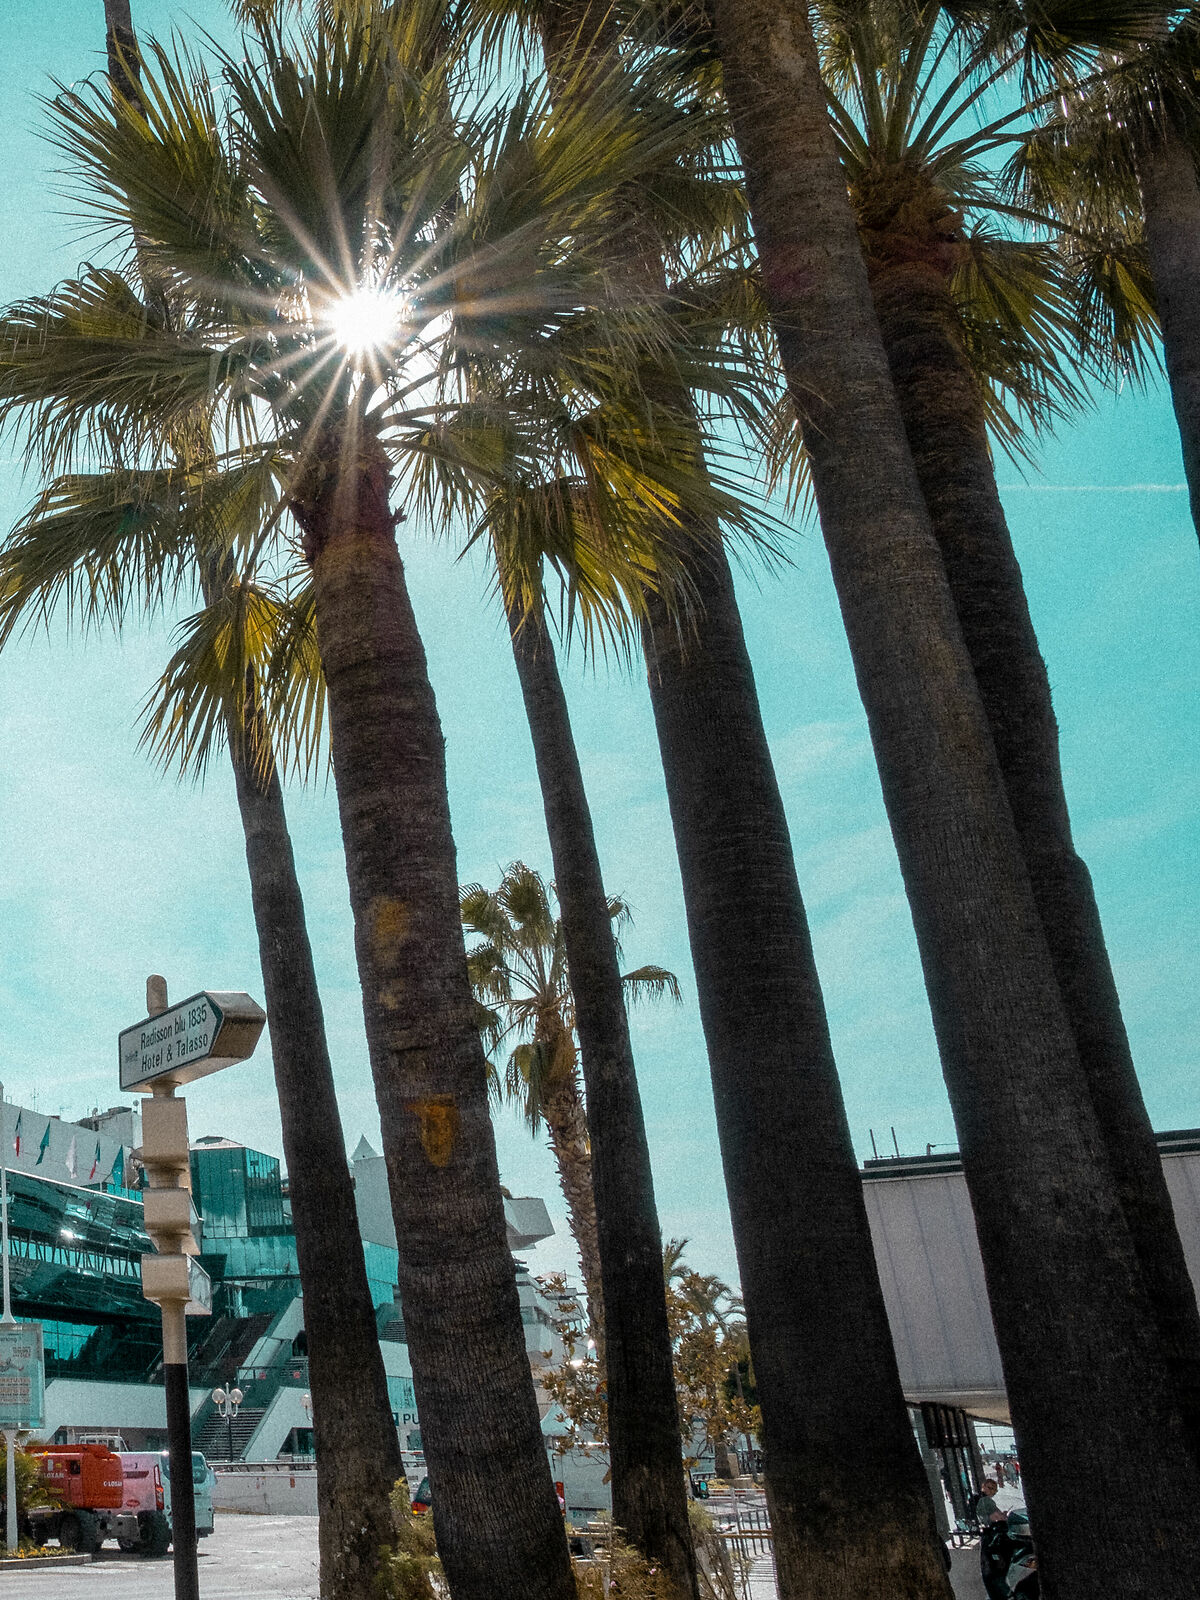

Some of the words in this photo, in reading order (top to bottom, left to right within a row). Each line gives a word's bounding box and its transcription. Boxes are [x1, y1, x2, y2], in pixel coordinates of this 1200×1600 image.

[140, 1024, 173, 1051] Radisson
[174, 1015, 186, 1033] blu
[188, 1003, 207, 1029] 1835
[141, 1048, 163, 1073] Hotel
[166, 1043, 173, 1063] &
[176, 1033, 208, 1058] Talasso
